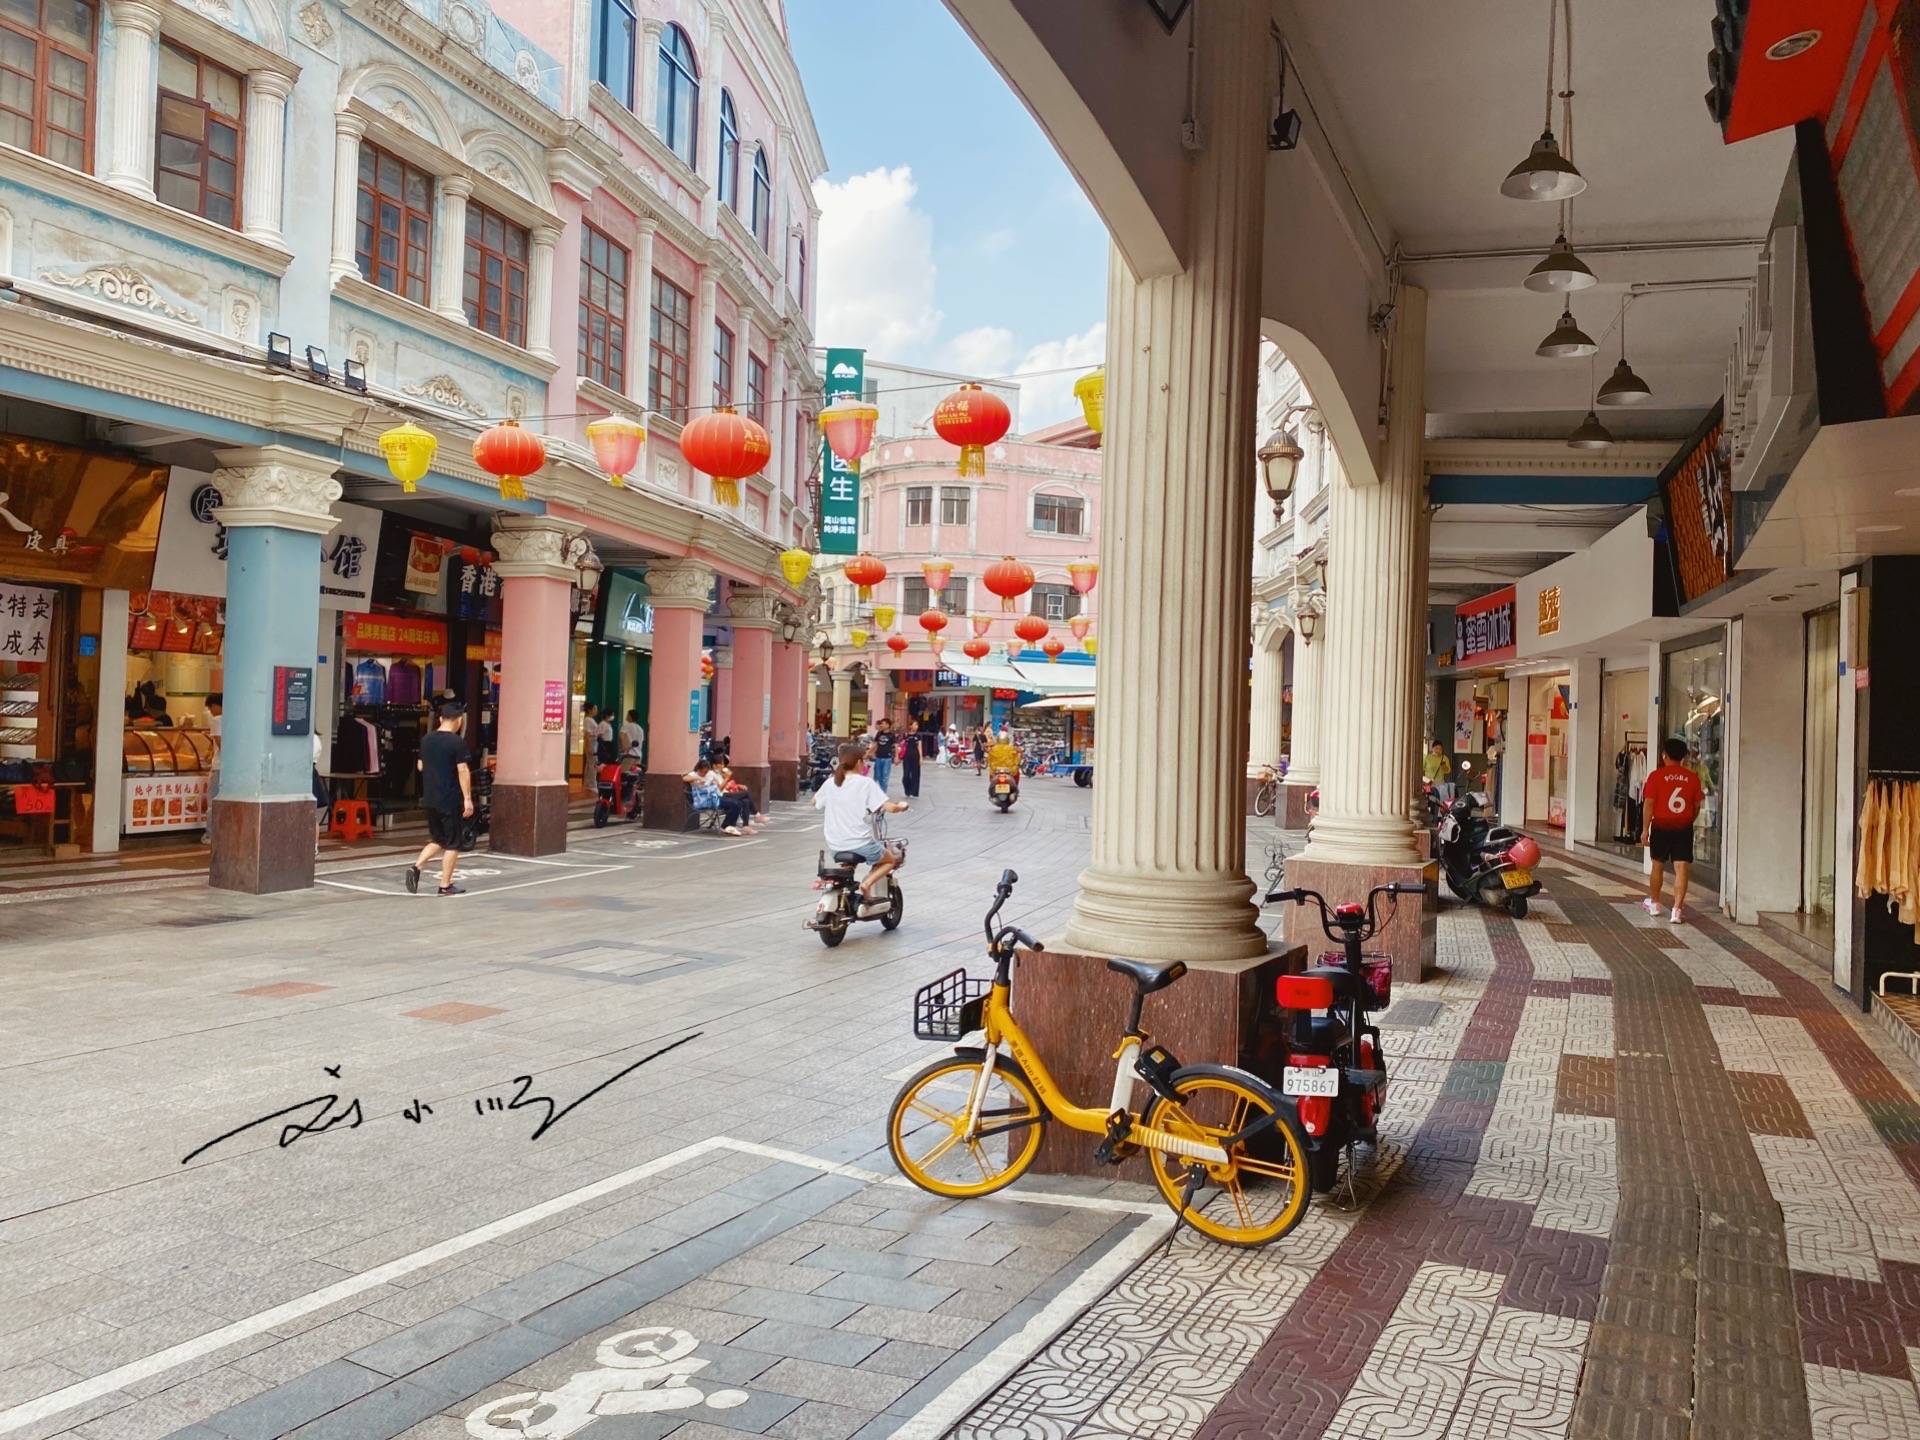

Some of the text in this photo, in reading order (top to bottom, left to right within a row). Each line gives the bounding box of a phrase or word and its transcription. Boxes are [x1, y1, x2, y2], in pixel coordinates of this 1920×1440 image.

[24, 530, 69, 555] 皮具
[1465, 602, 1510, 655] 蜜雪冰城
[2, 630, 46, 656] 成本
[1668, 787, 1686, 814] 6
[1287, 1079, 1334, 1093] 975867
